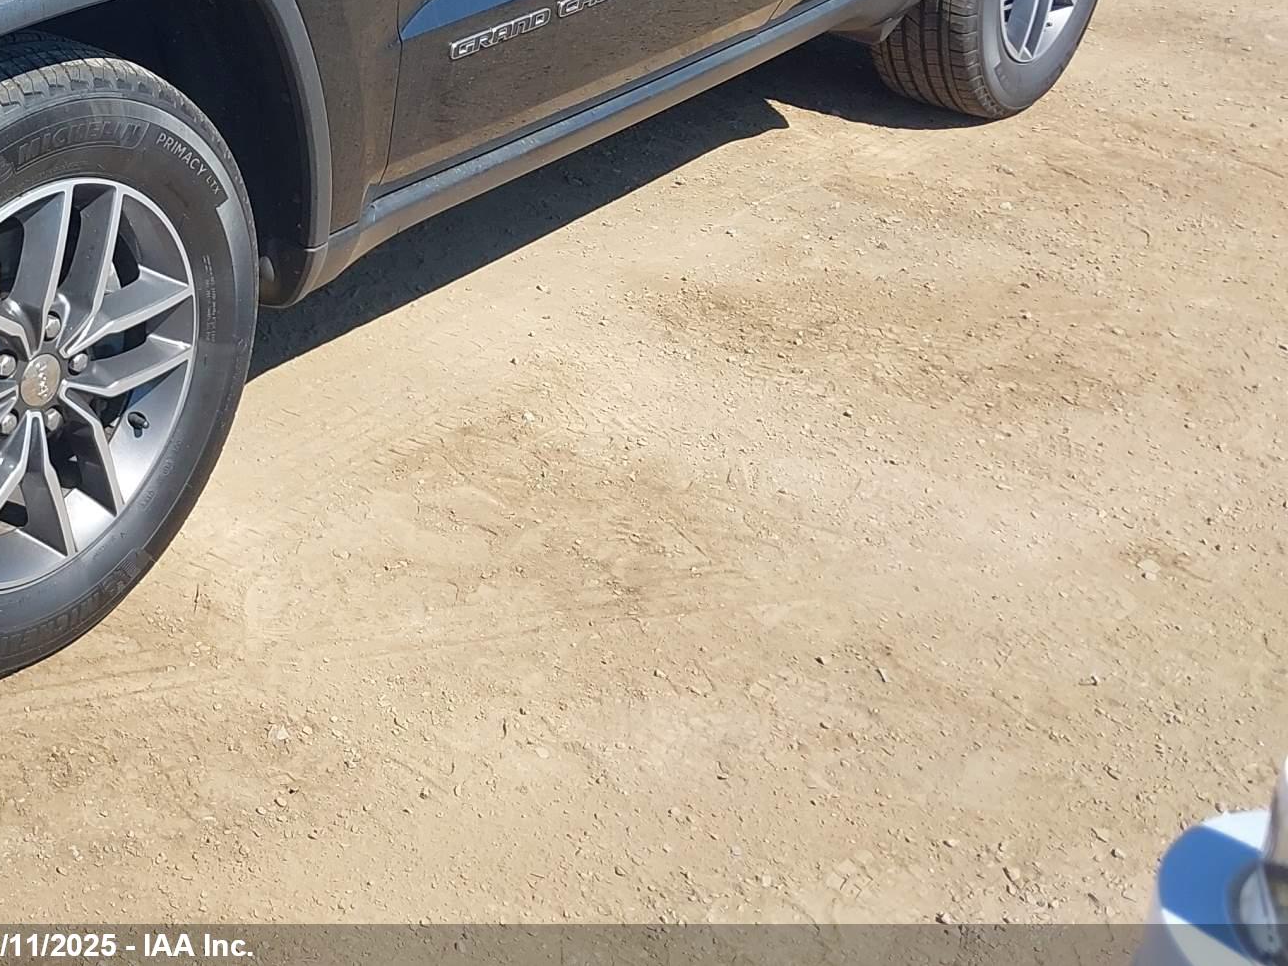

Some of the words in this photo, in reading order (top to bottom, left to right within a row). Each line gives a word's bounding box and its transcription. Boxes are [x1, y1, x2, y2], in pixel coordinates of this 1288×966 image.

[449, 6, 552, 61] GRAND
[17, 120, 144, 165] MICHELIN
[156, 132, 208, 177] PRIMACY
[204, 175, 222, 196] LTX
